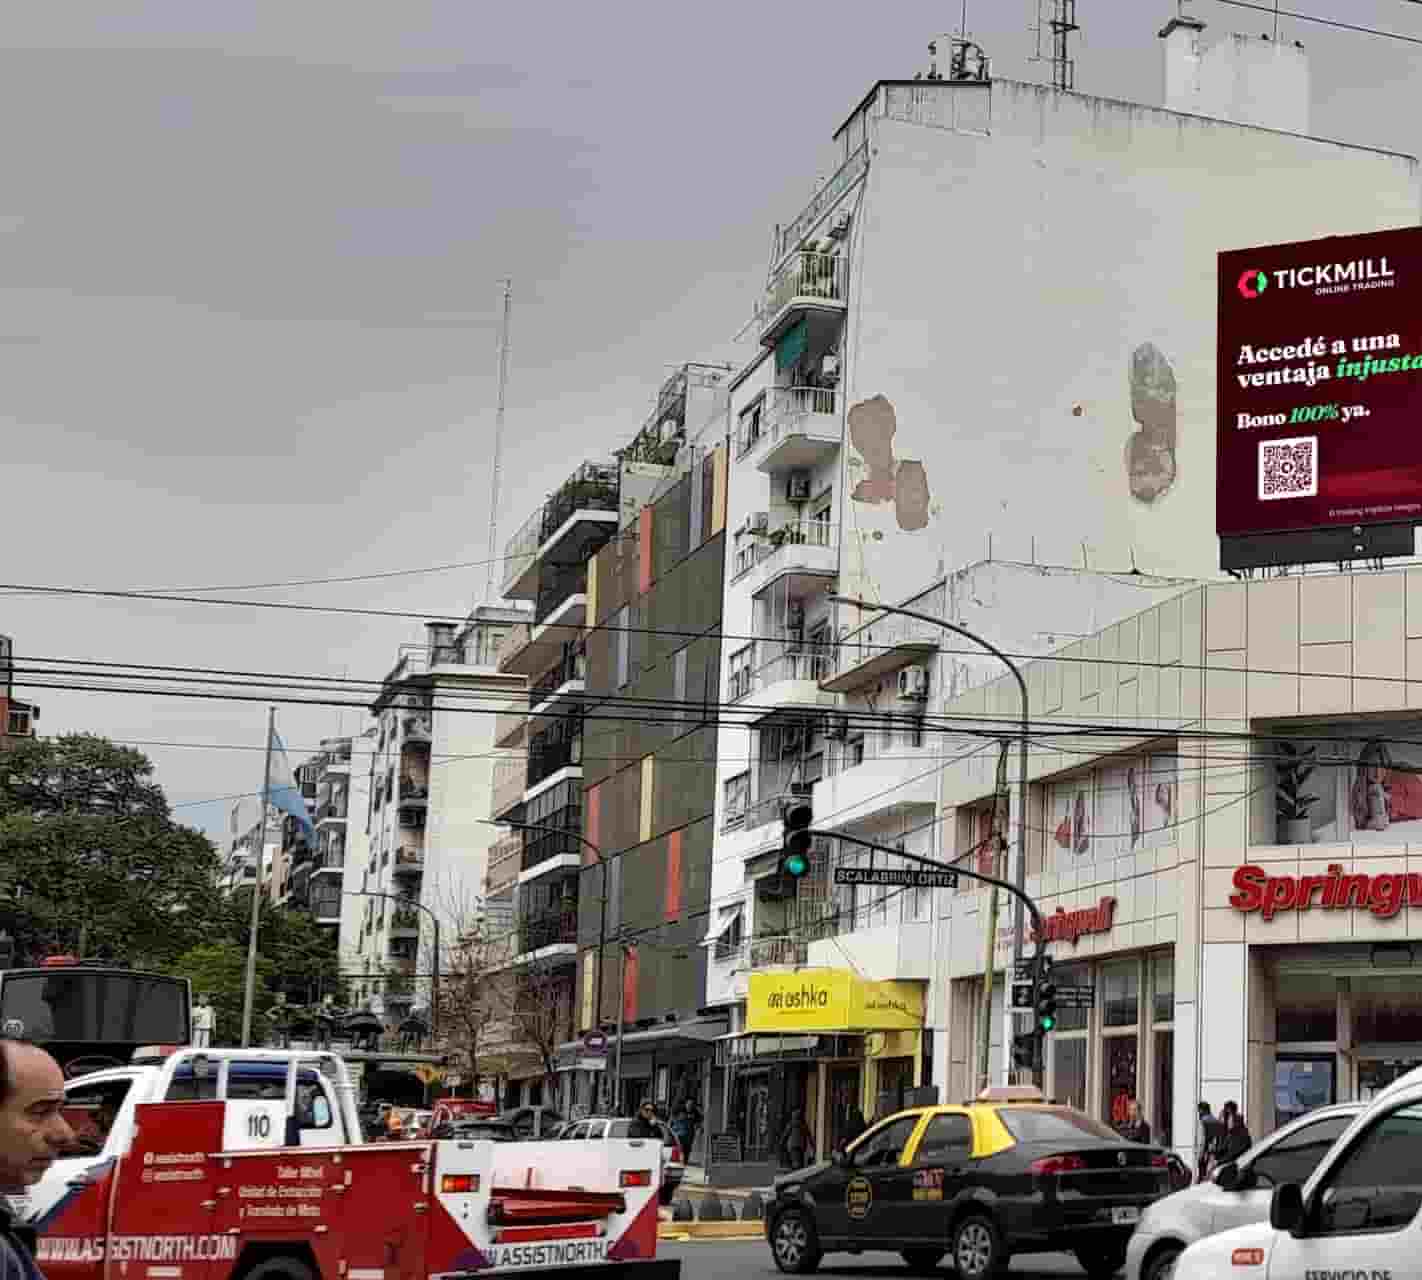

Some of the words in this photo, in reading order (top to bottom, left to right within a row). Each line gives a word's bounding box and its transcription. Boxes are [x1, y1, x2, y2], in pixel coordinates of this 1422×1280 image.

[1273, 257, 1395, 289] TICKMILL
[1315, 284, 1349, 296] ONLINE
[1352, 279, 1395, 292] TRADING
[1237, 336, 1327, 366] Accedé
[1331, 340, 1346, 355] a
[1352, 333, 1401, 353] una
[1237, 361, 1330, 388] ventaja
[1236, 412, 1287, 430] Bono
[1289, 402, 1339, 424] 100%
[1341, 405, 1371, 423] ya.
[918, 872, 956, 886] ORTIZ
[247, 1115, 270, 1138] 110
